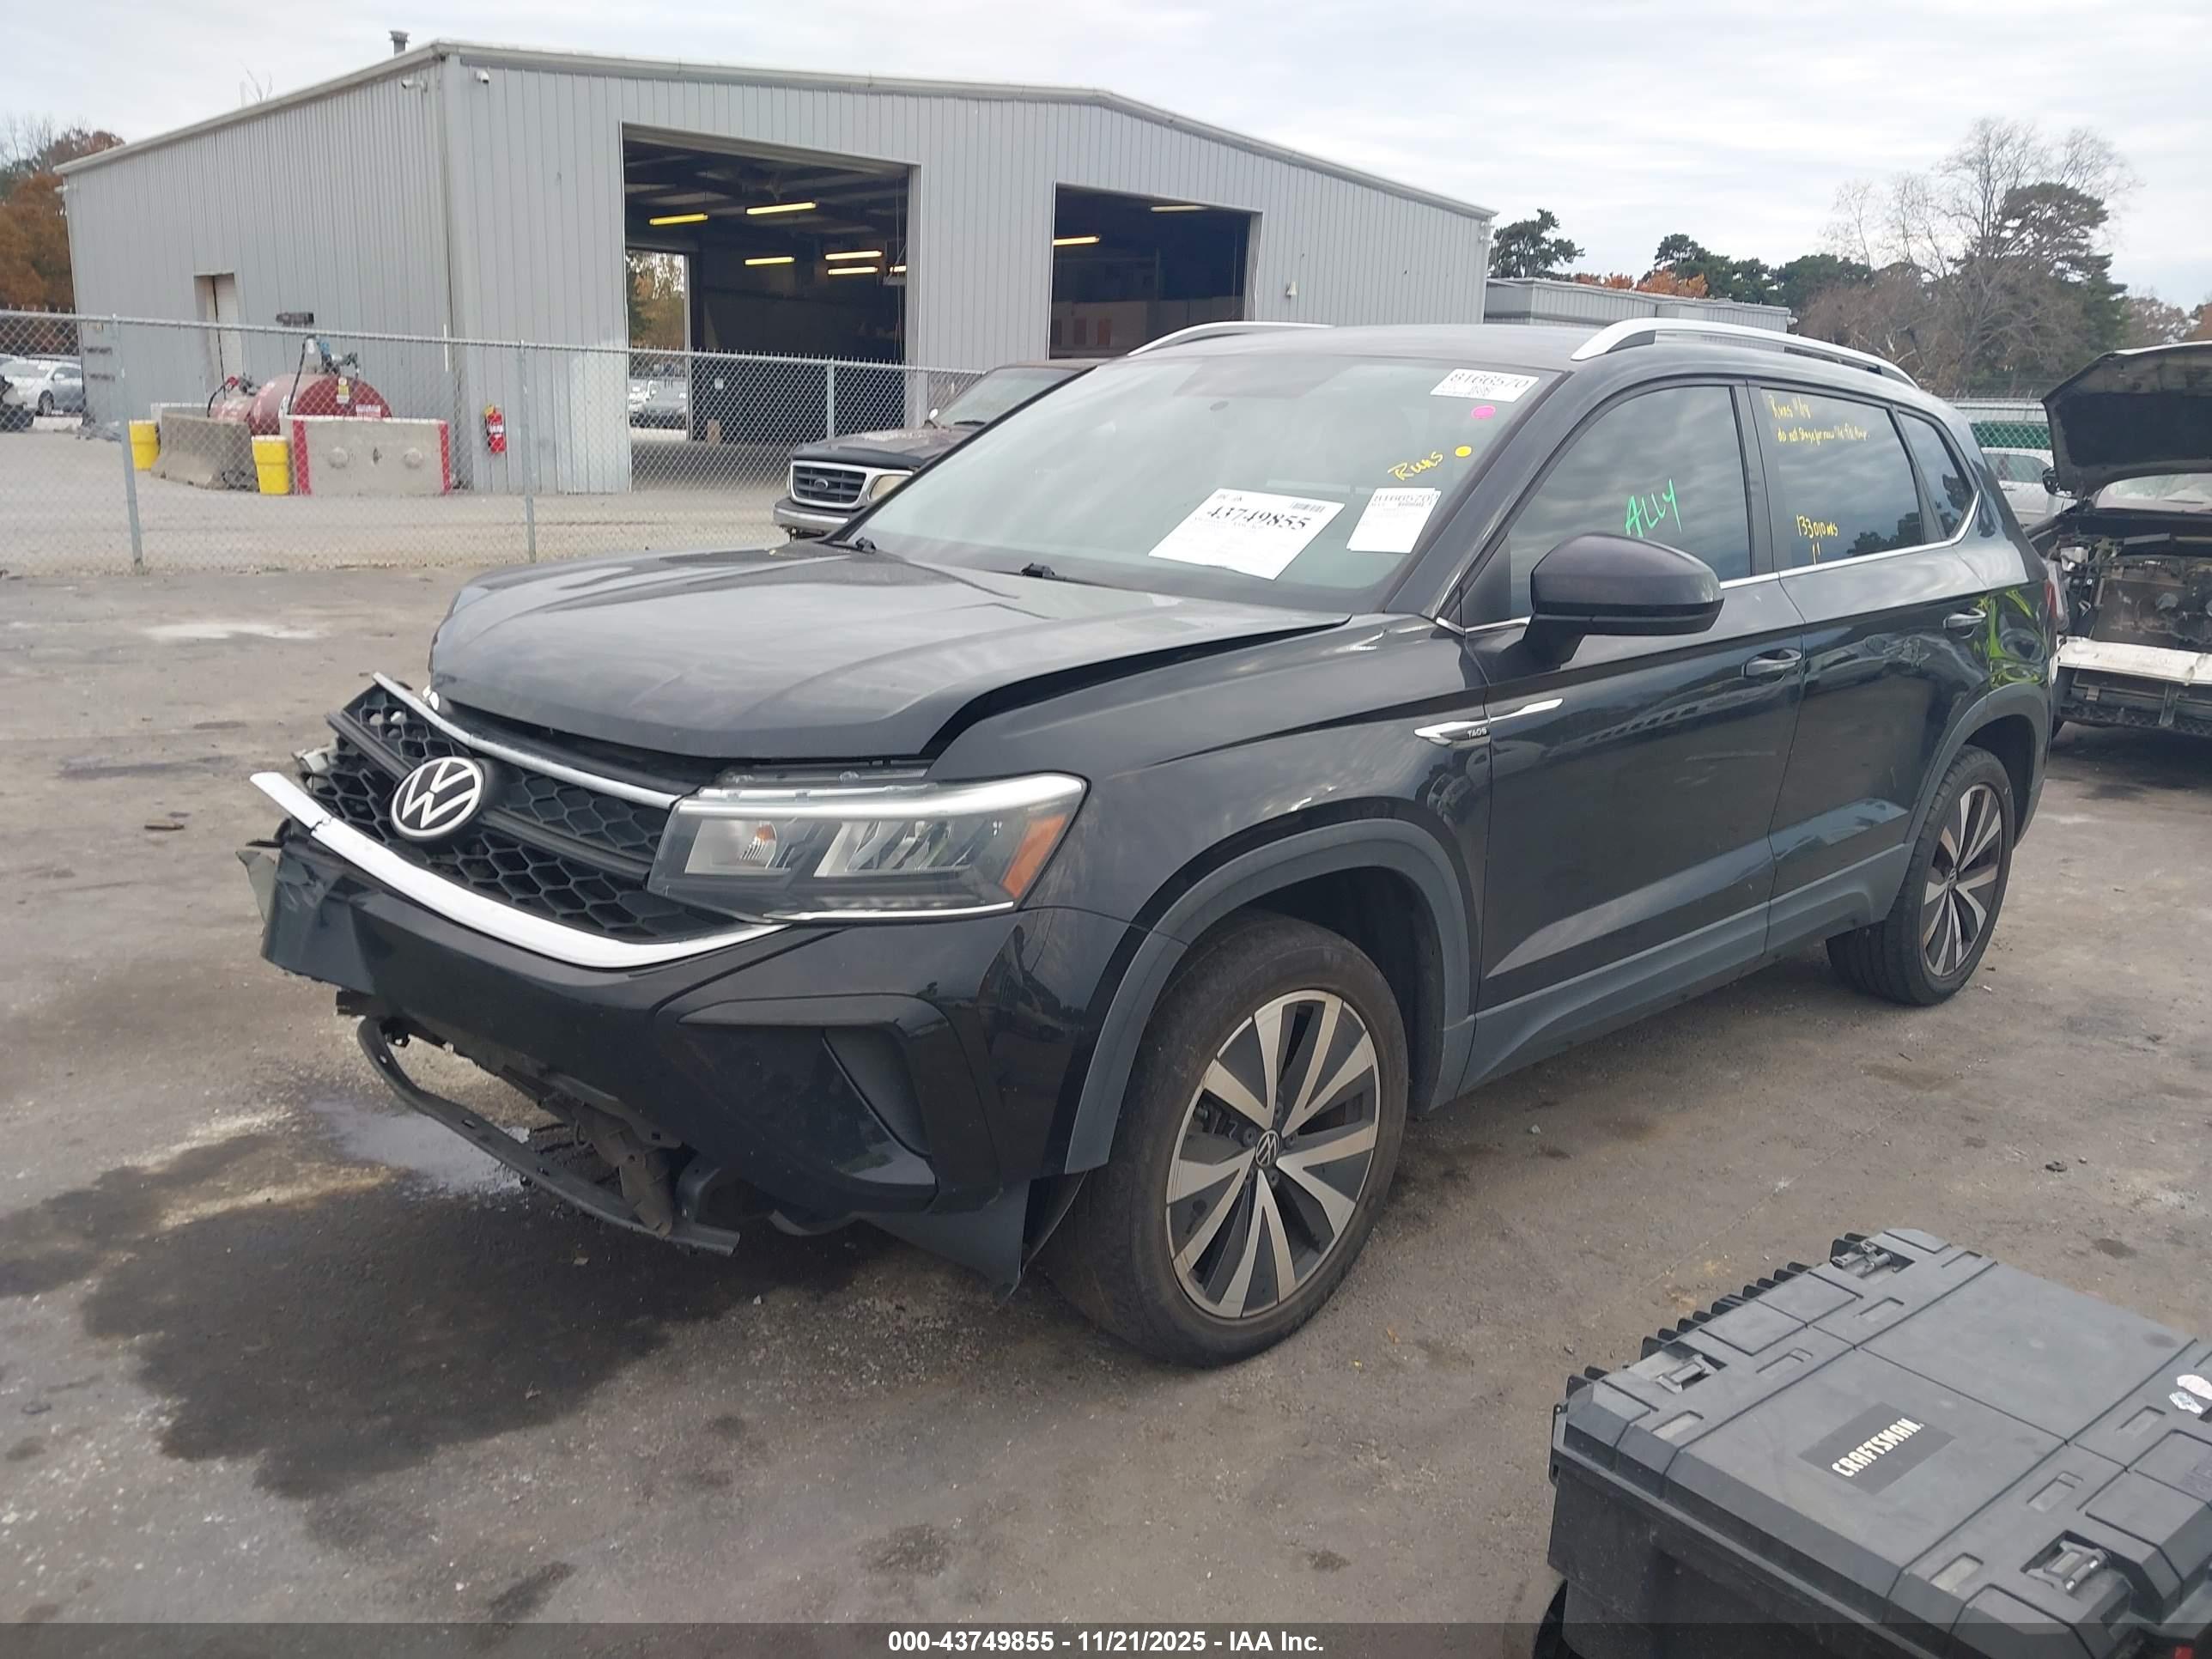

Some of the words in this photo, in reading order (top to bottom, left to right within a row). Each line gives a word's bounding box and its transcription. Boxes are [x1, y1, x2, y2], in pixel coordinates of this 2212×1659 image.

[1387, 451, 1443, 481] Runs
[1206, 505, 1312, 530] 43749855
[1625, 477, 1682, 538] ALLY
[1467, 727, 1487, 739] TAOS
[1832, 1417, 1922, 1477] CRAFTSMAN
